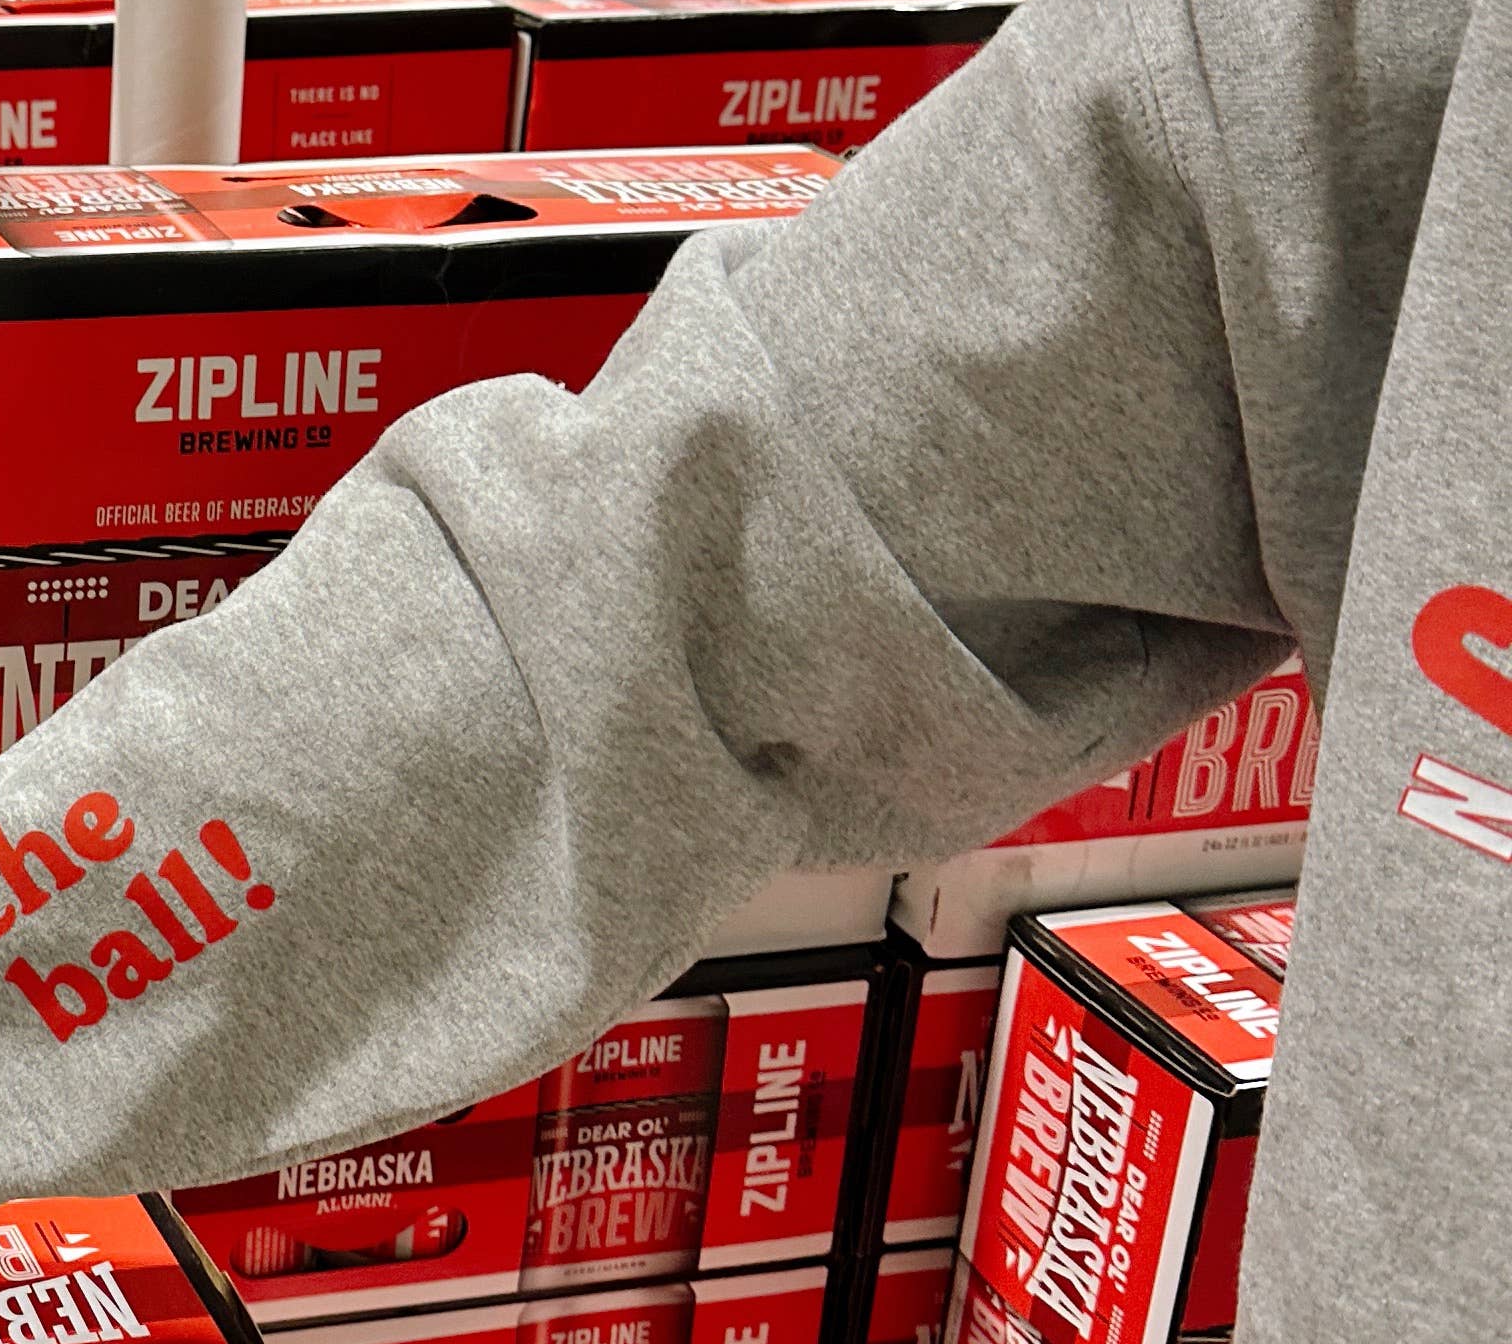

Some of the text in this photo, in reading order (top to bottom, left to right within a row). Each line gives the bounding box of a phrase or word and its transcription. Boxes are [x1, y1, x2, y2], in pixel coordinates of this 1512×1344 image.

[290, 87, 336, 104] THERE
[718, 75, 882, 128] ZIPLINE
[291, 131, 337, 149] PLACE
[287, 177, 466, 197] NEBRASKA
[135, 349, 382, 423] ZIPLINE
[179, 427, 299, 455] BREWING
[96, 495, 321, 528] OFFICIAL BEER OF NEBRASK
[5, 818, 277, 1044] ball!
[577, 1033, 685, 1074] ZIPLINE
[577, 1120, 644, 1145] DEAR
[739, 1038, 808, 1218] ZIPLINE
[1000, 1051, 1072, 1250] BREW
[277, 1149, 434, 1201] NEBRASKA
[1026, 1025, 1140, 1341] NEBRASKA
[548, 1190, 678, 1255] BREW
